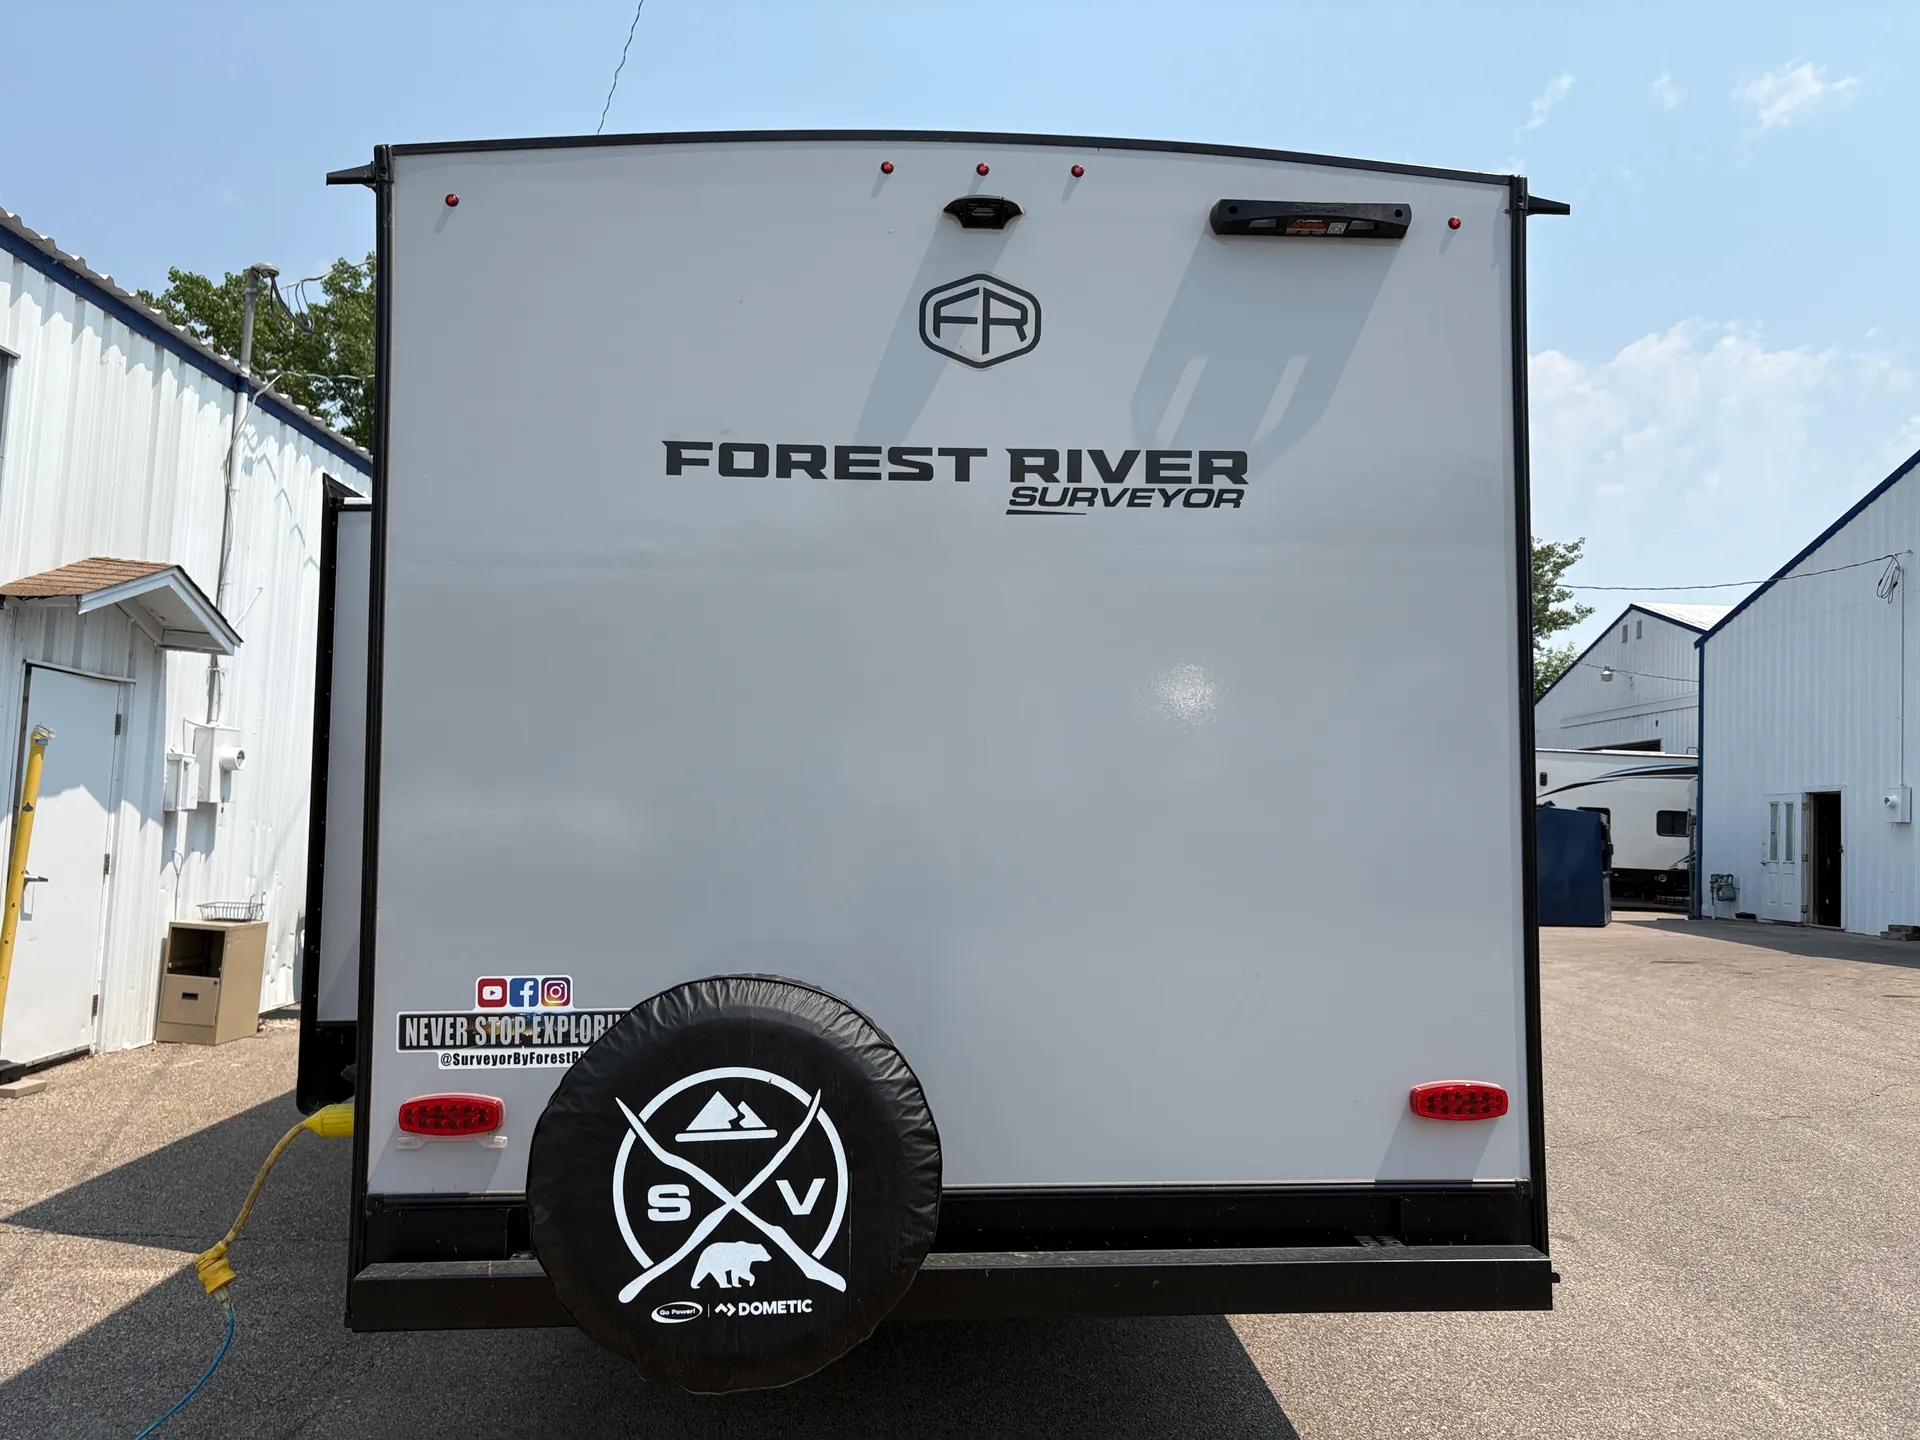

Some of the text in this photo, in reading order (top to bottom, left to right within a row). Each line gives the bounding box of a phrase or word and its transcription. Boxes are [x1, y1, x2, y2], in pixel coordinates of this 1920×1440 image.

[662, 441, 1250, 485] FOREST RIVER
[1009, 486, 1245, 509] SURVEYOR
[405, 1016, 468, 1047] NEVER
[475, 1015, 526, 1046] STOP
[647, 1178, 826, 1222] S V
[738, 1299, 813, 1316] DOMETIC
